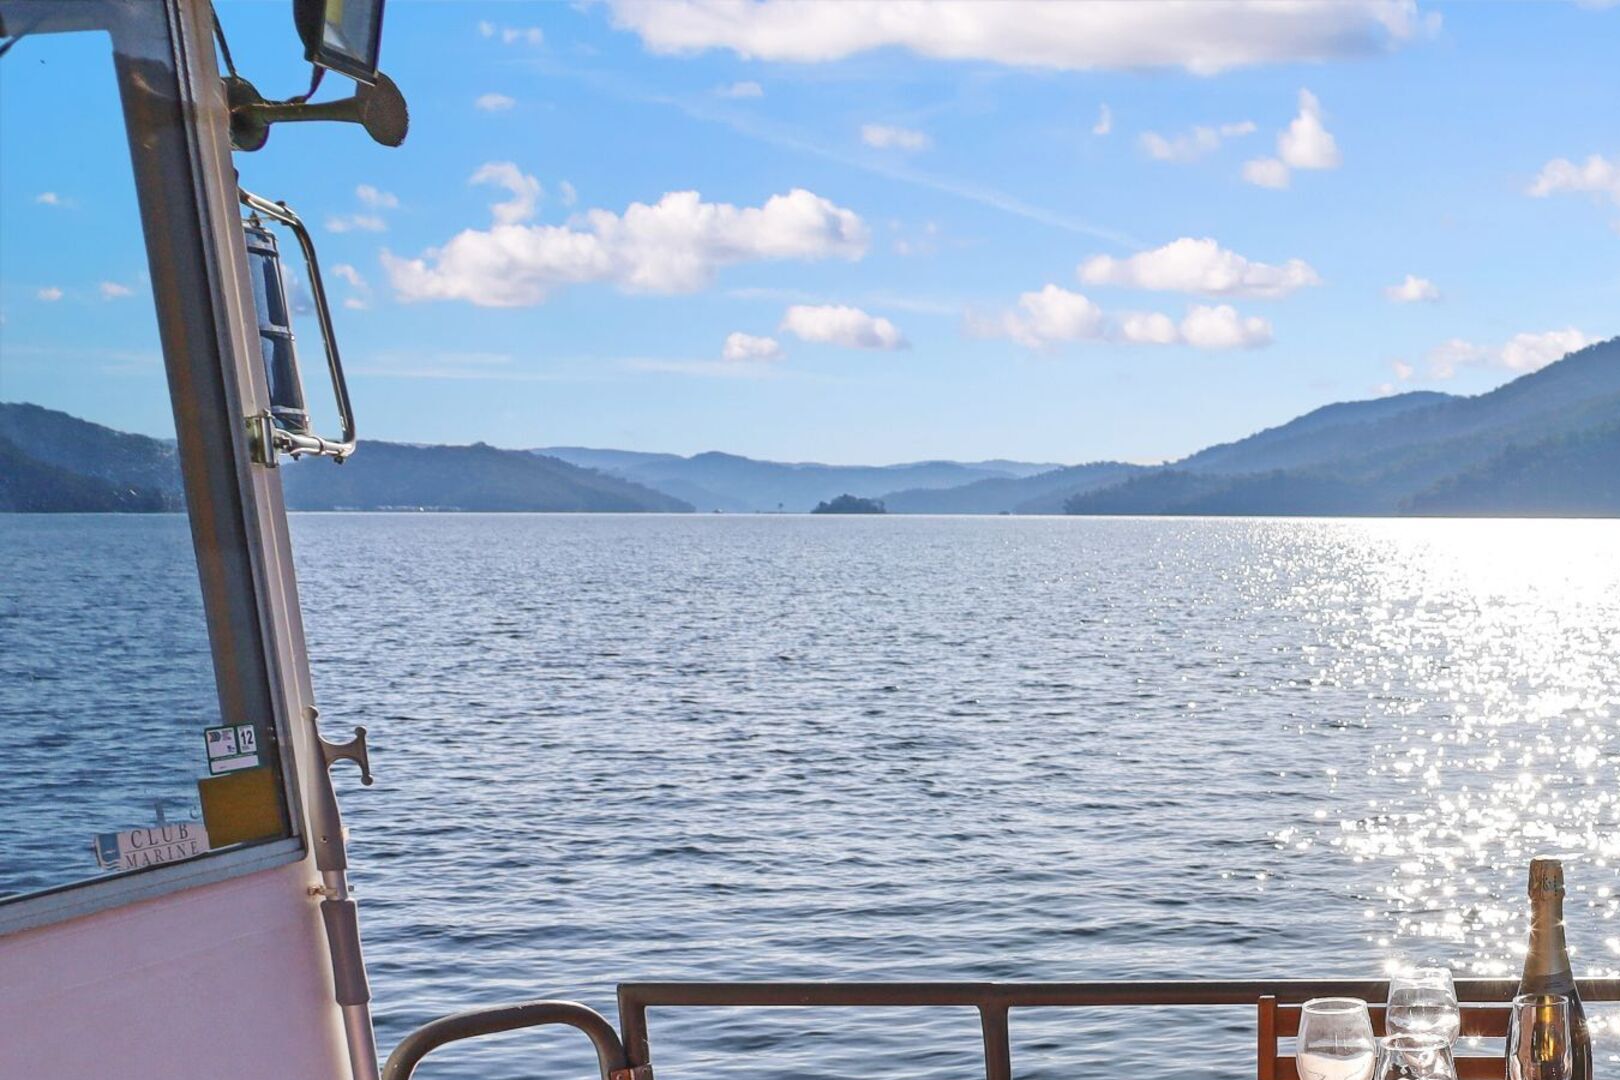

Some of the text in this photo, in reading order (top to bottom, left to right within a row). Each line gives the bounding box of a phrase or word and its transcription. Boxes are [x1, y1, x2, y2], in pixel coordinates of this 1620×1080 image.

[241, 730, 254, 745] 12
[131, 823, 189, 849] CLUB
[125, 841, 199, 869] MARINE
